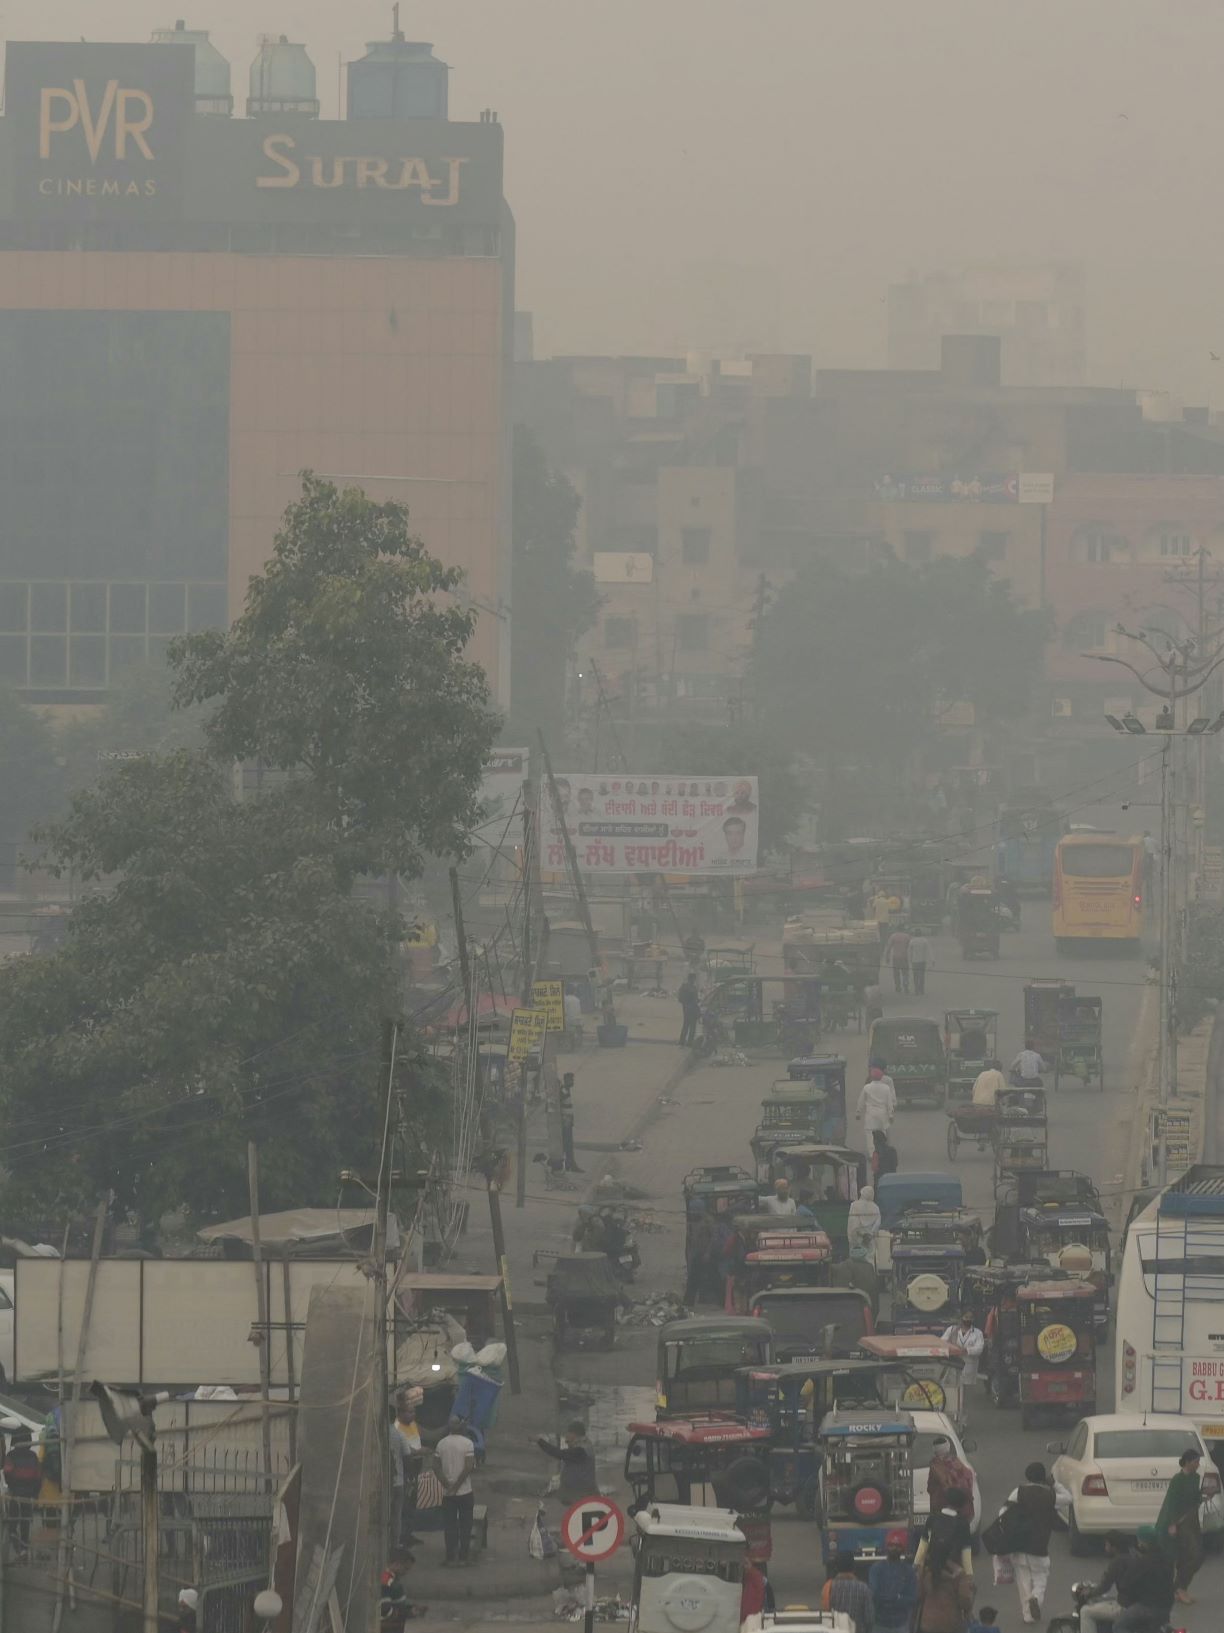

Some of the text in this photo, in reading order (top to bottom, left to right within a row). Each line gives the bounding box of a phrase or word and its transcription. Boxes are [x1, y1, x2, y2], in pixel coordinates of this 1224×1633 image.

[39, 78, 156, 166] PVR
[256, 133, 470, 206] SURAJ
[39, 177, 157, 197] CINEMAS
[1192, 1362, 1217, 1376] BABBU
[849, 1424, 882, 1432] ROCKY
[581, 1510, 609, 1546] P
